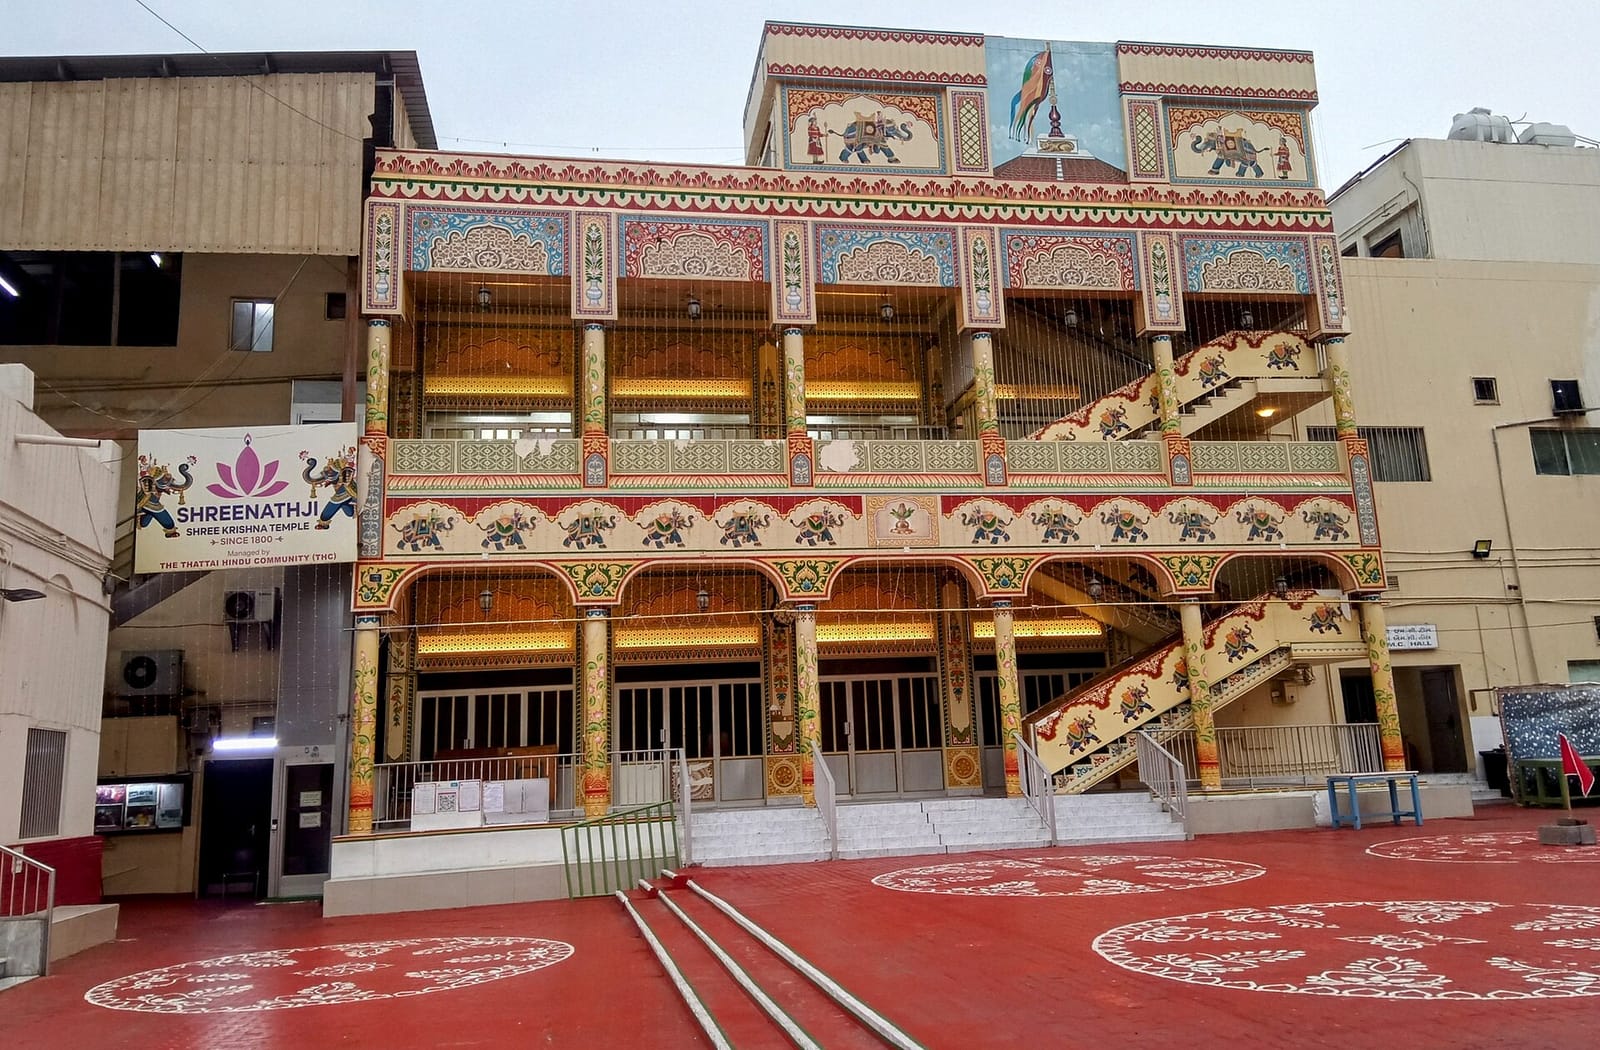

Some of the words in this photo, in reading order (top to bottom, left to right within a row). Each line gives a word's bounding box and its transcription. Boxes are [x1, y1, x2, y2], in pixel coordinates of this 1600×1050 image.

[176, 501, 318, 523] SHREENATHJI
[186, 526, 220, 536] SHREE
[221, 524, 267, 535] KRISHNA
[269, 522, 310, 533] TEMPLE
[220, 537, 249, 546] SINCE
[250, 535, 273, 544] 1800
[227, 549, 260, 558] Managed
[261, 548, 270, 557] by
[159, 561, 179, 570] THE
[180, 559, 219, 569] THATTAI
[221, 558, 251, 567] HINDU
[253, 554, 310, 565] COMMUNITY
[312, 552, 337, 562] (THC)
